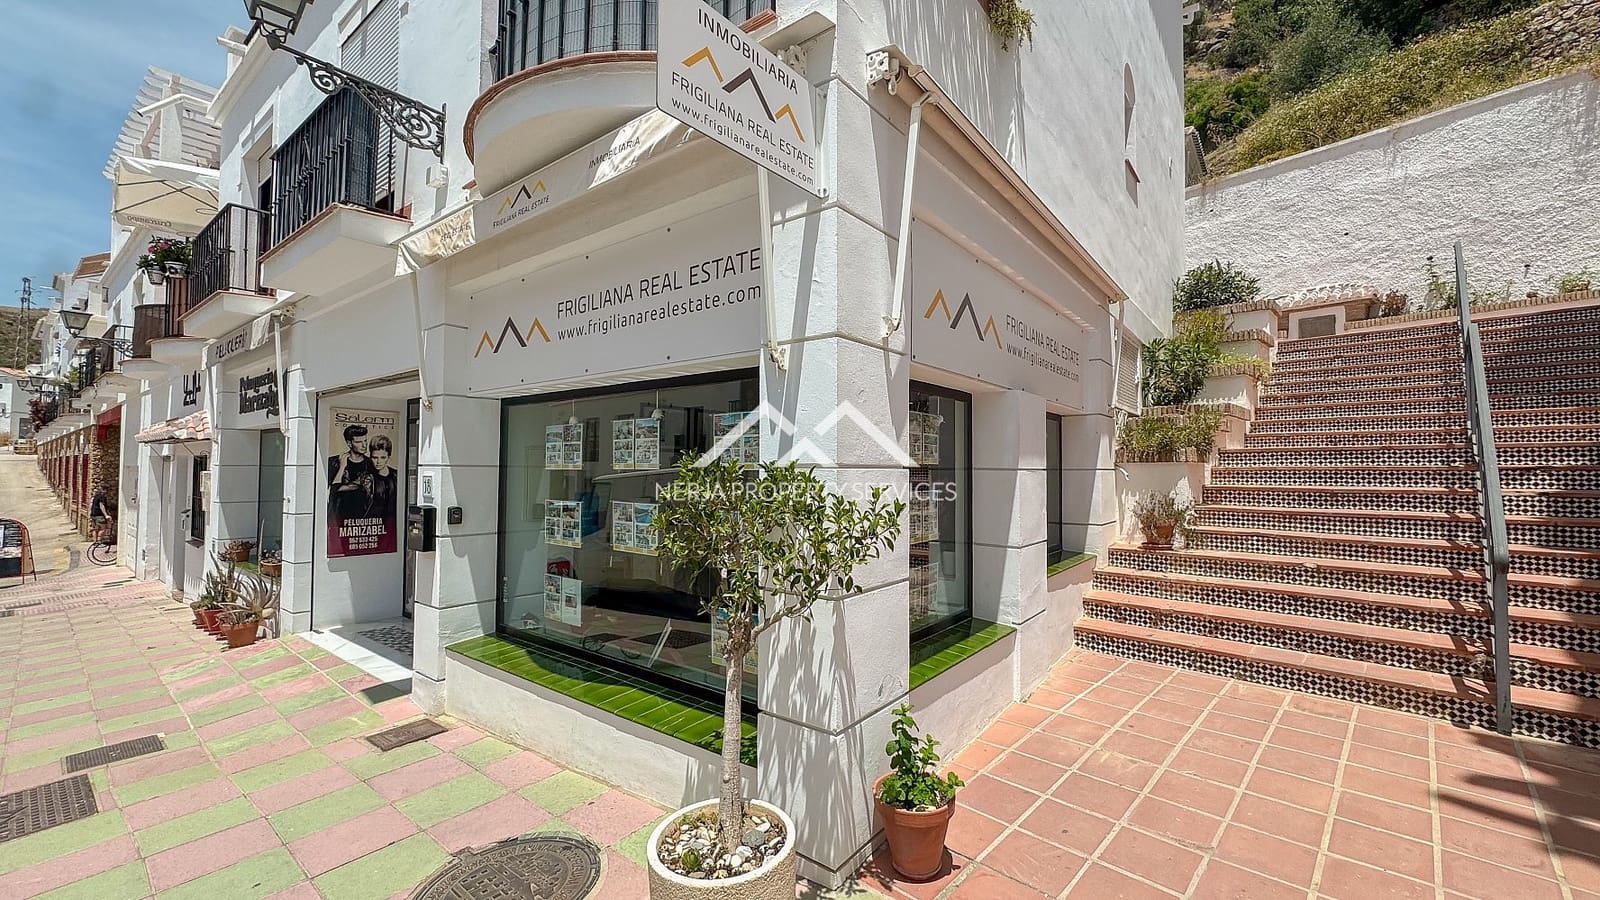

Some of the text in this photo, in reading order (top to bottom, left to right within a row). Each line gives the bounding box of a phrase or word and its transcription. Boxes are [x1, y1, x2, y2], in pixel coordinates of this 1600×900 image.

[698, 8, 798, 95] INMOBILIARIA
[671, 72, 814, 169] FRIGILIANA REAL ESTATE
[671, 97, 814, 186] www.frigilianarealestate.com
[518, 205, 530, 217] REAL
[531, 195, 550, 210] ESTATE
[557, 247, 761, 319] FRIGILIANA REAL ESTATE
[557, 284, 761, 341] www.frigilianarealestate.com
[1006, 314, 1080, 366] FRIGILIANA REAL ESTATE
[339, 525, 387, 537] MARIZABEL
